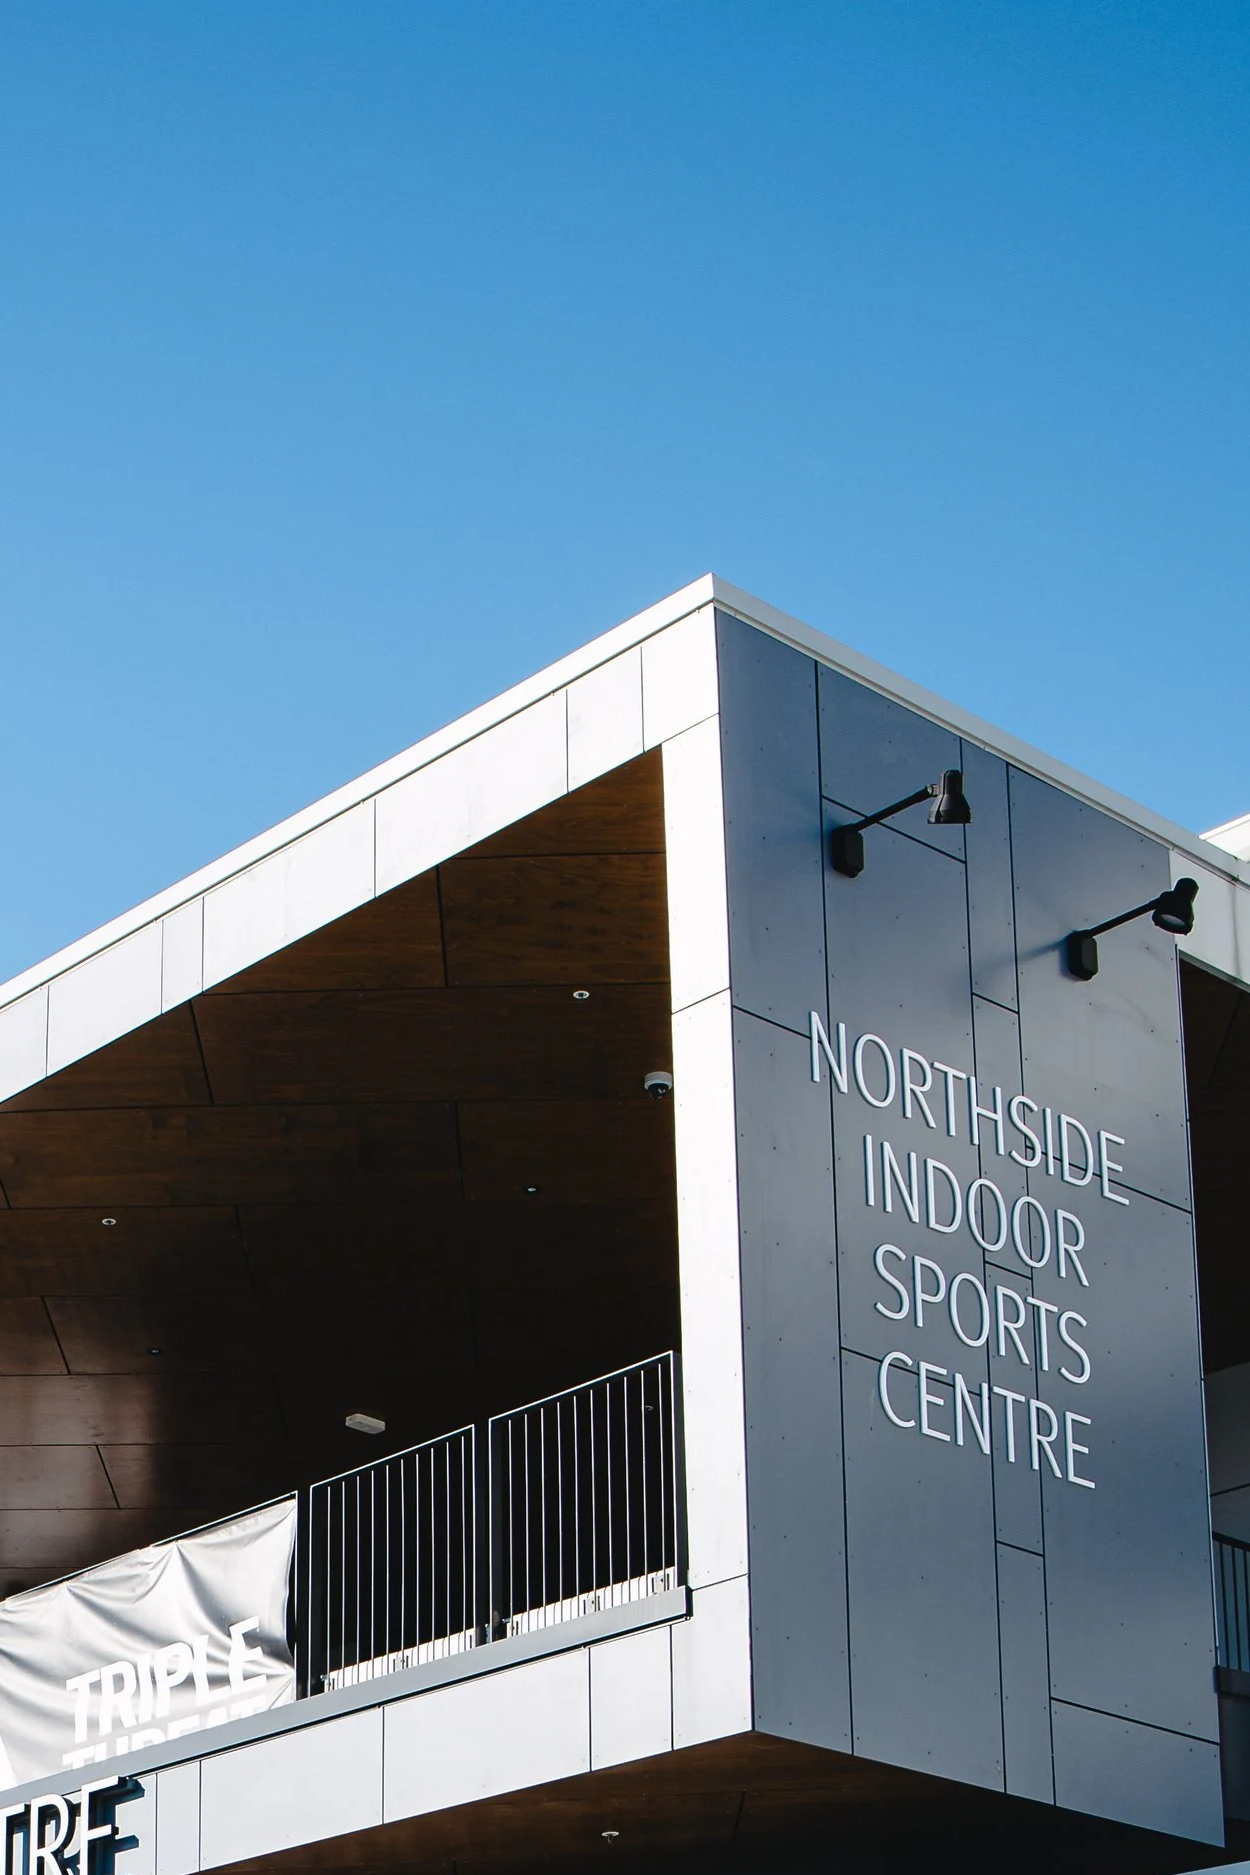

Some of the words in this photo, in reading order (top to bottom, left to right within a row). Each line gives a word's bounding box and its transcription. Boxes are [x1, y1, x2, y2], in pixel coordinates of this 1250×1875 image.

[810, 1011, 1129, 1206] NORTHSIDE
[865, 1135, 1089, 1287] INDOOR
[874, 1244, 1090, 1384] SPORTS
[879, 1352, 1095, 1488] CENTRE
[65, 1616, 268, 1743] TRIPLE
